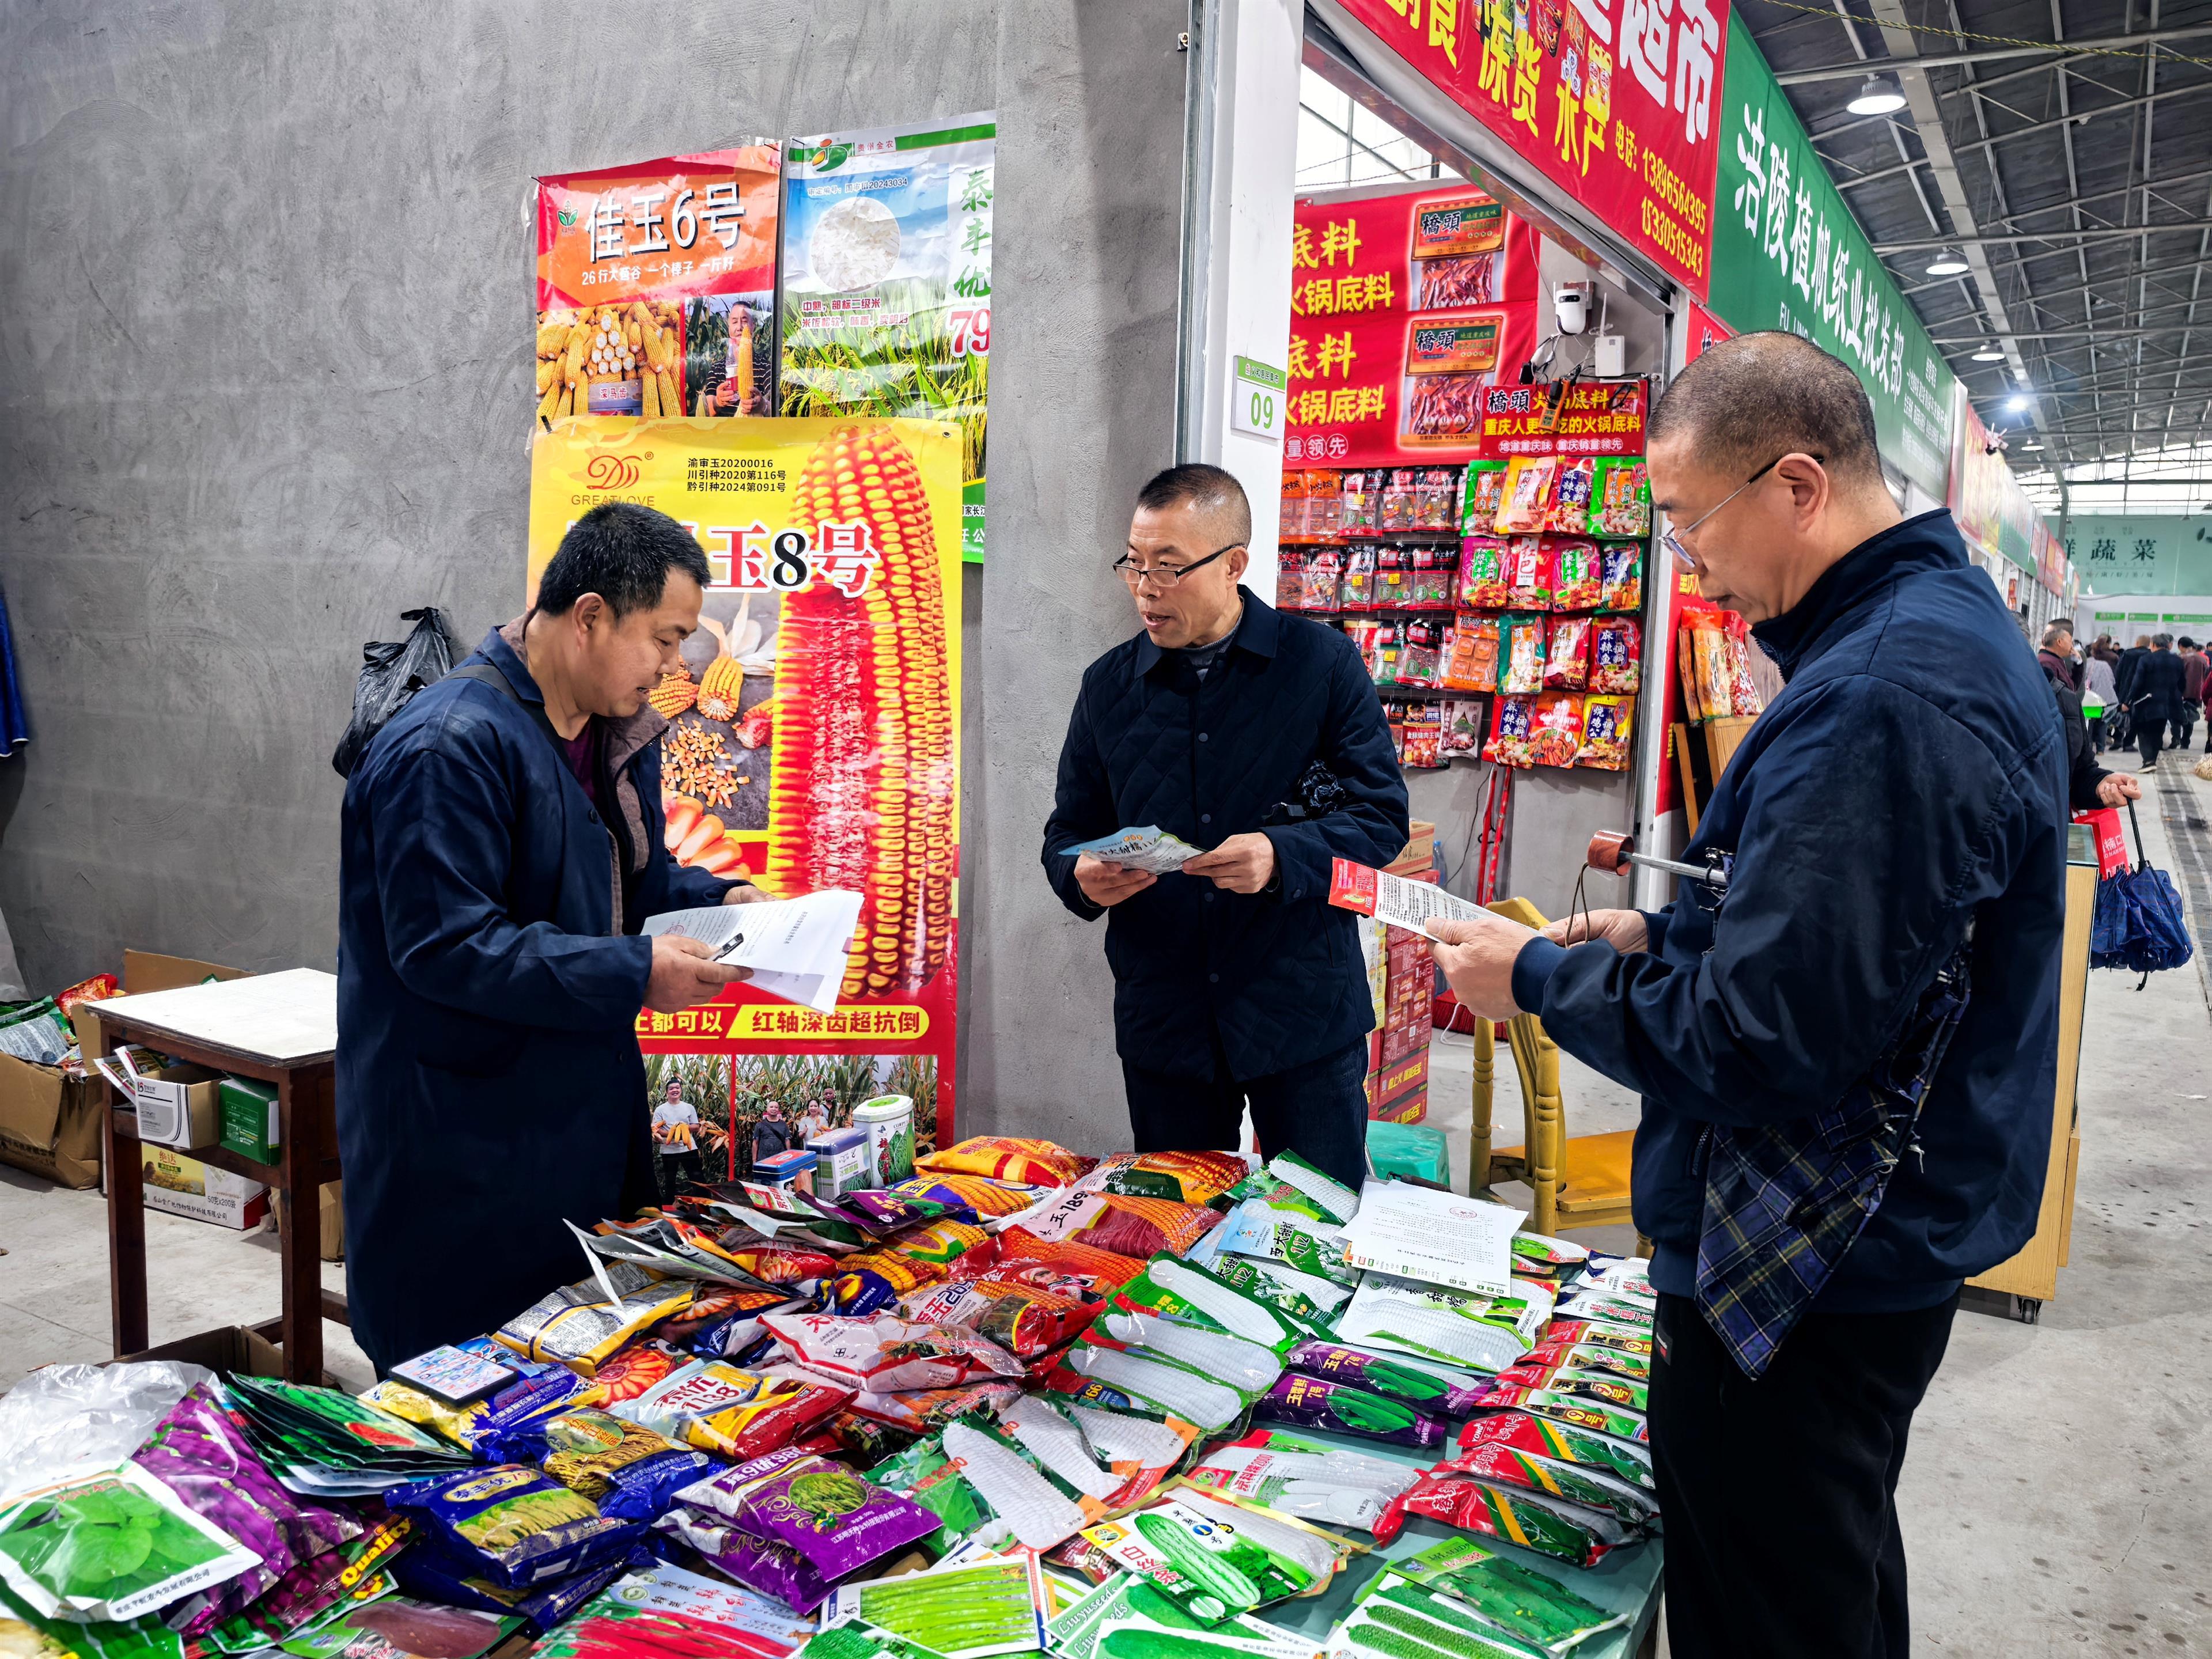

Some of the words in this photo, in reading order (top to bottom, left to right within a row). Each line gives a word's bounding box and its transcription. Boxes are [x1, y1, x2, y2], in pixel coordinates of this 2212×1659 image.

[857, 140, 894, 151] 贵州金农
[1642, 146, 1707, 236] 13896564395
[585, 181, 747, 264] 佳玉6号
[1641, 195, 1703, 278] 15330515343
[949, 308, 991, 354] 79
[599, 386, 628, 400] 深马齿
[1487, 389, 1530, 414] 橋頭
[1251, 392, 1274, 429] 09
[687, 457, 774, 468] 渝审玉20200016
[687, 469, 787, 480] 川引种2020第116号
[686, 482, 786, 493] 黔引种2024第091号
[571, 495, 655, 506] GREATLOVE
[752, 1010, 921, 1034] 红轴深齿超抗倒
[1290, 1234, 1309, 1254] 112
[1230, 1267, 1255, 1288] 112
